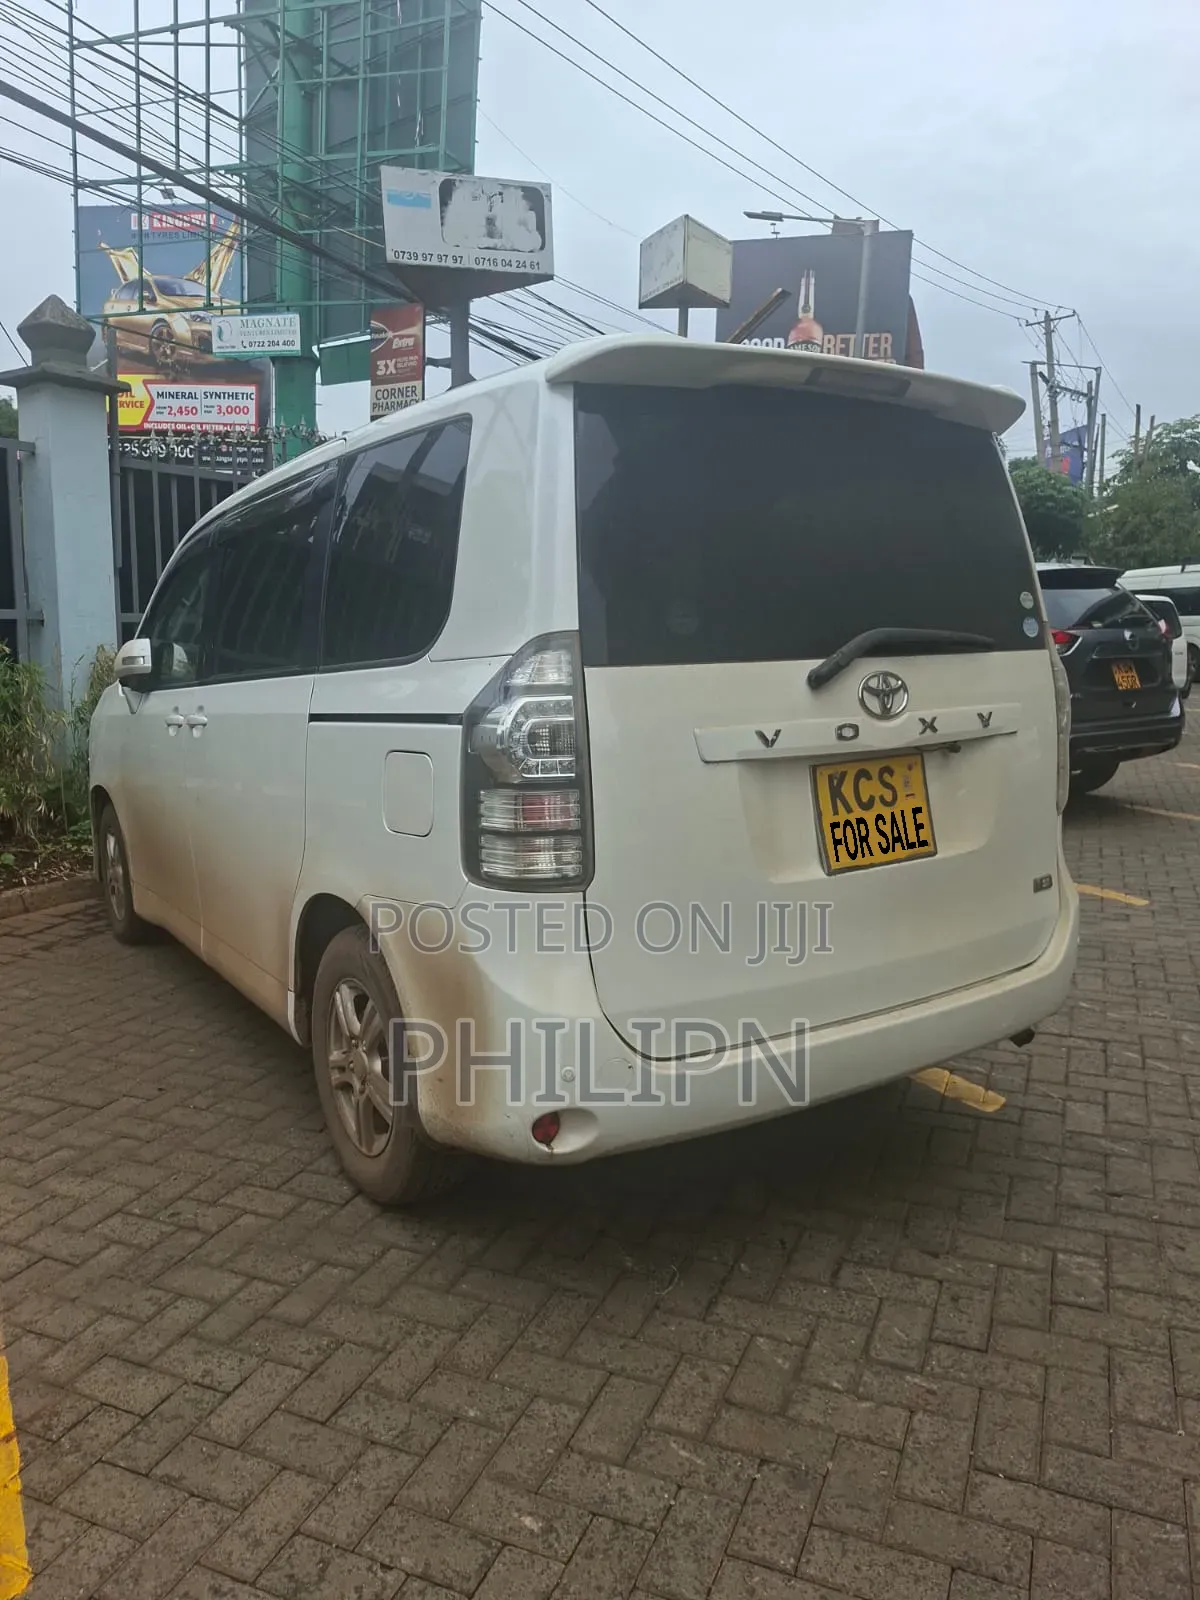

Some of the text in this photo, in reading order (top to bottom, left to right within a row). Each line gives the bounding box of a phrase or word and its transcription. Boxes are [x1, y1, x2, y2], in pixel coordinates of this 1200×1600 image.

[393, 250, 541, 270] 0739 97 97 97 0716 04 24 61
[240, 316, 297, 328] MAGNATE
[248, 340, 266, 348] 0722
[281, 339, 296, 347] 400
[376, 358, 397, 376] 3X
[156, 391, 255, 401] MINERAL SYNTHETIC
[375, 385, 418, 401] CORNER
[118, 400, 145, 409] RVICE
[167, 405, 198, 417] 2,450
[216, 404, 250, 417] 3,000
[754, 711, 993, 749] VOXY
[827, 764, 898, 817] KCS
